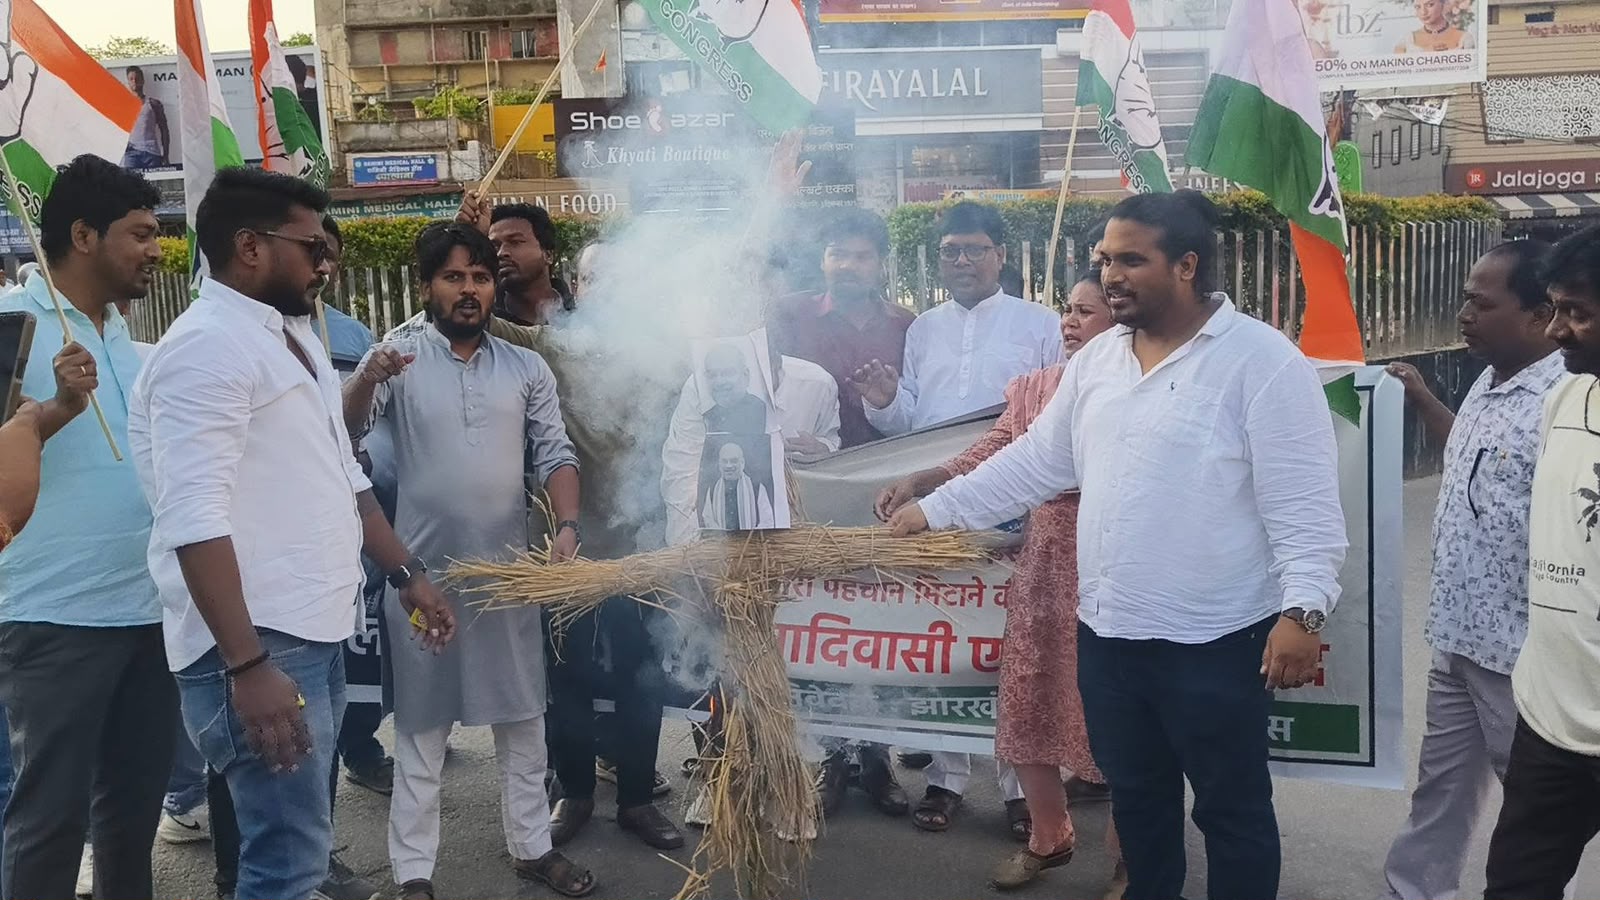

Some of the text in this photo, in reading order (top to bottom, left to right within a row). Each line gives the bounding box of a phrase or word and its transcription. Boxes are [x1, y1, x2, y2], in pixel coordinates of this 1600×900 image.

[660, 0, 753, 103] CONGRESS
[1315, 59, 1348, 72] 50%
[1350, 60, 1367, 70] ON
[1369, 57, 1414, 69] MAKING
[1416, 53, 1472, 67] CHARGES
[570, 112, 641, 131] Shoe
[607, 146, 729, 166] Khyati Boutique
[1492, 169, 1586, 189] Jalajoga
[326, 199, 458, 216] AMINI MEDICAL HALL
[560, 193, 616, 214] FOOD
[823, 578, 904, 604] पहचान
[908, 690, 997, 720] झारखं
